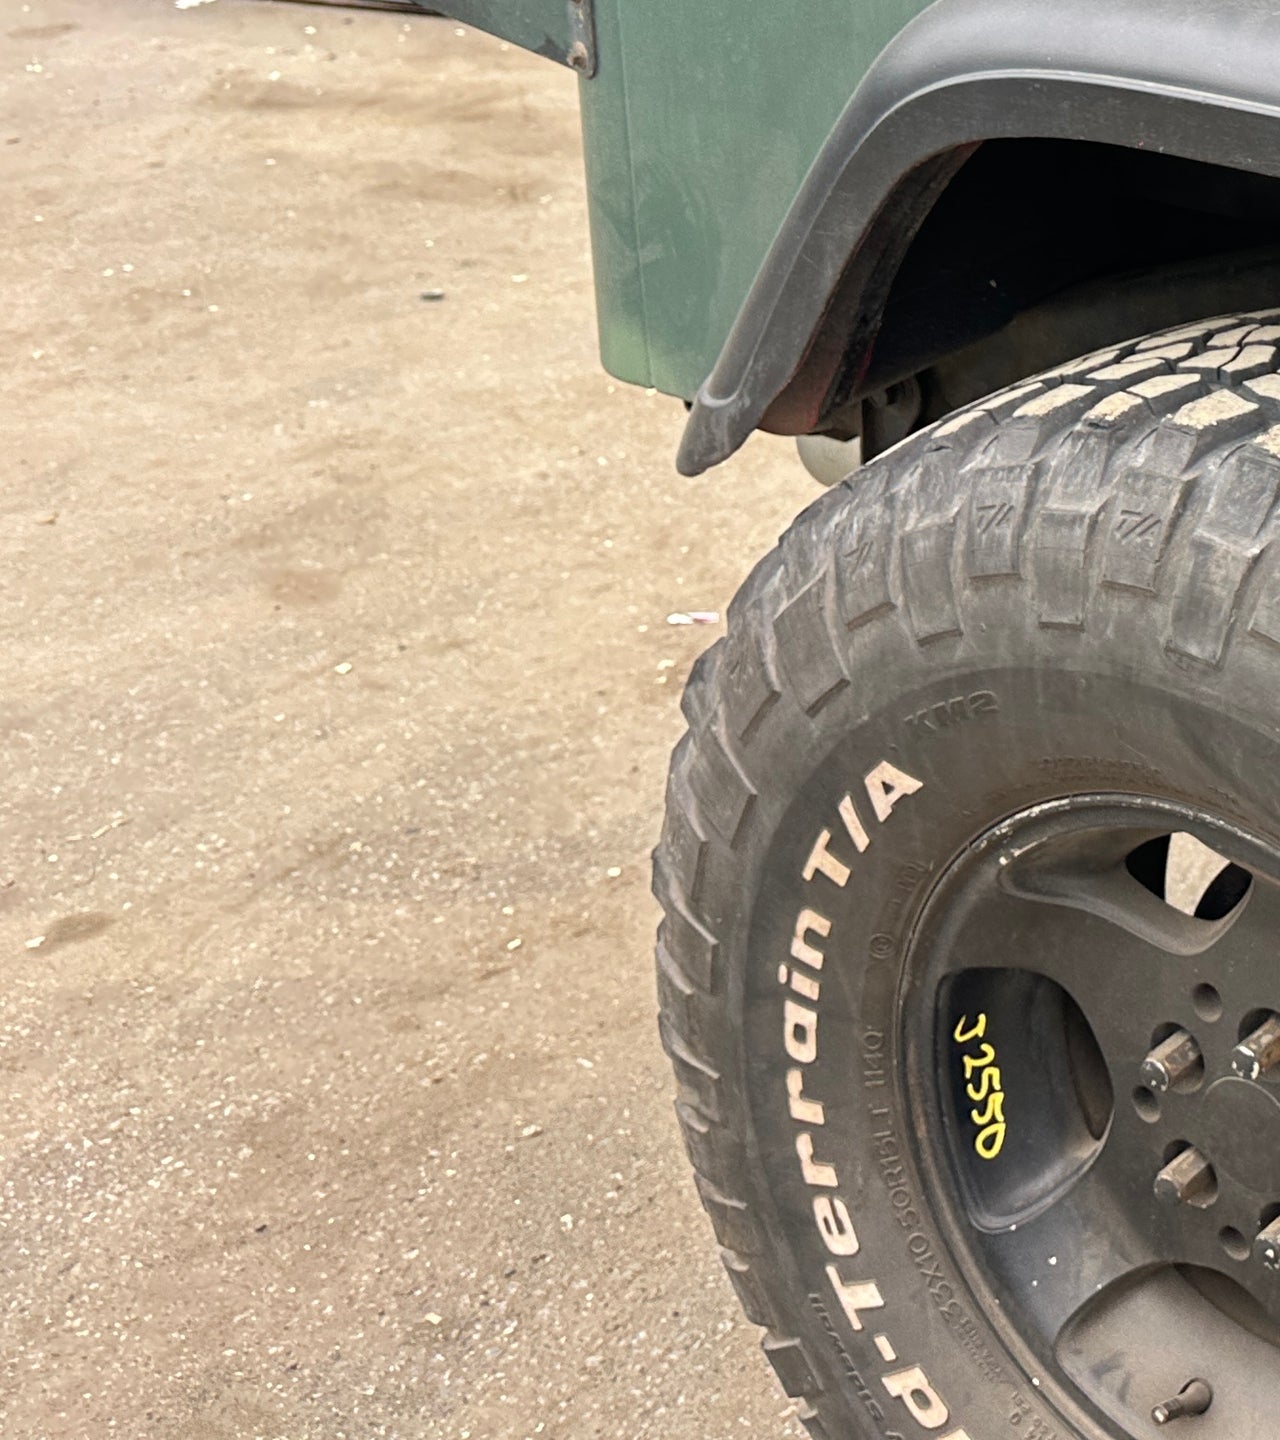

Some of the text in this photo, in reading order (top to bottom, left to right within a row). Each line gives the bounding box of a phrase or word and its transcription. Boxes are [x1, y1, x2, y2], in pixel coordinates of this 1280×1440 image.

[777, 760, 973, 1440] d-Terrain T/A
[954, 1012, 1008, 1160] J2550
